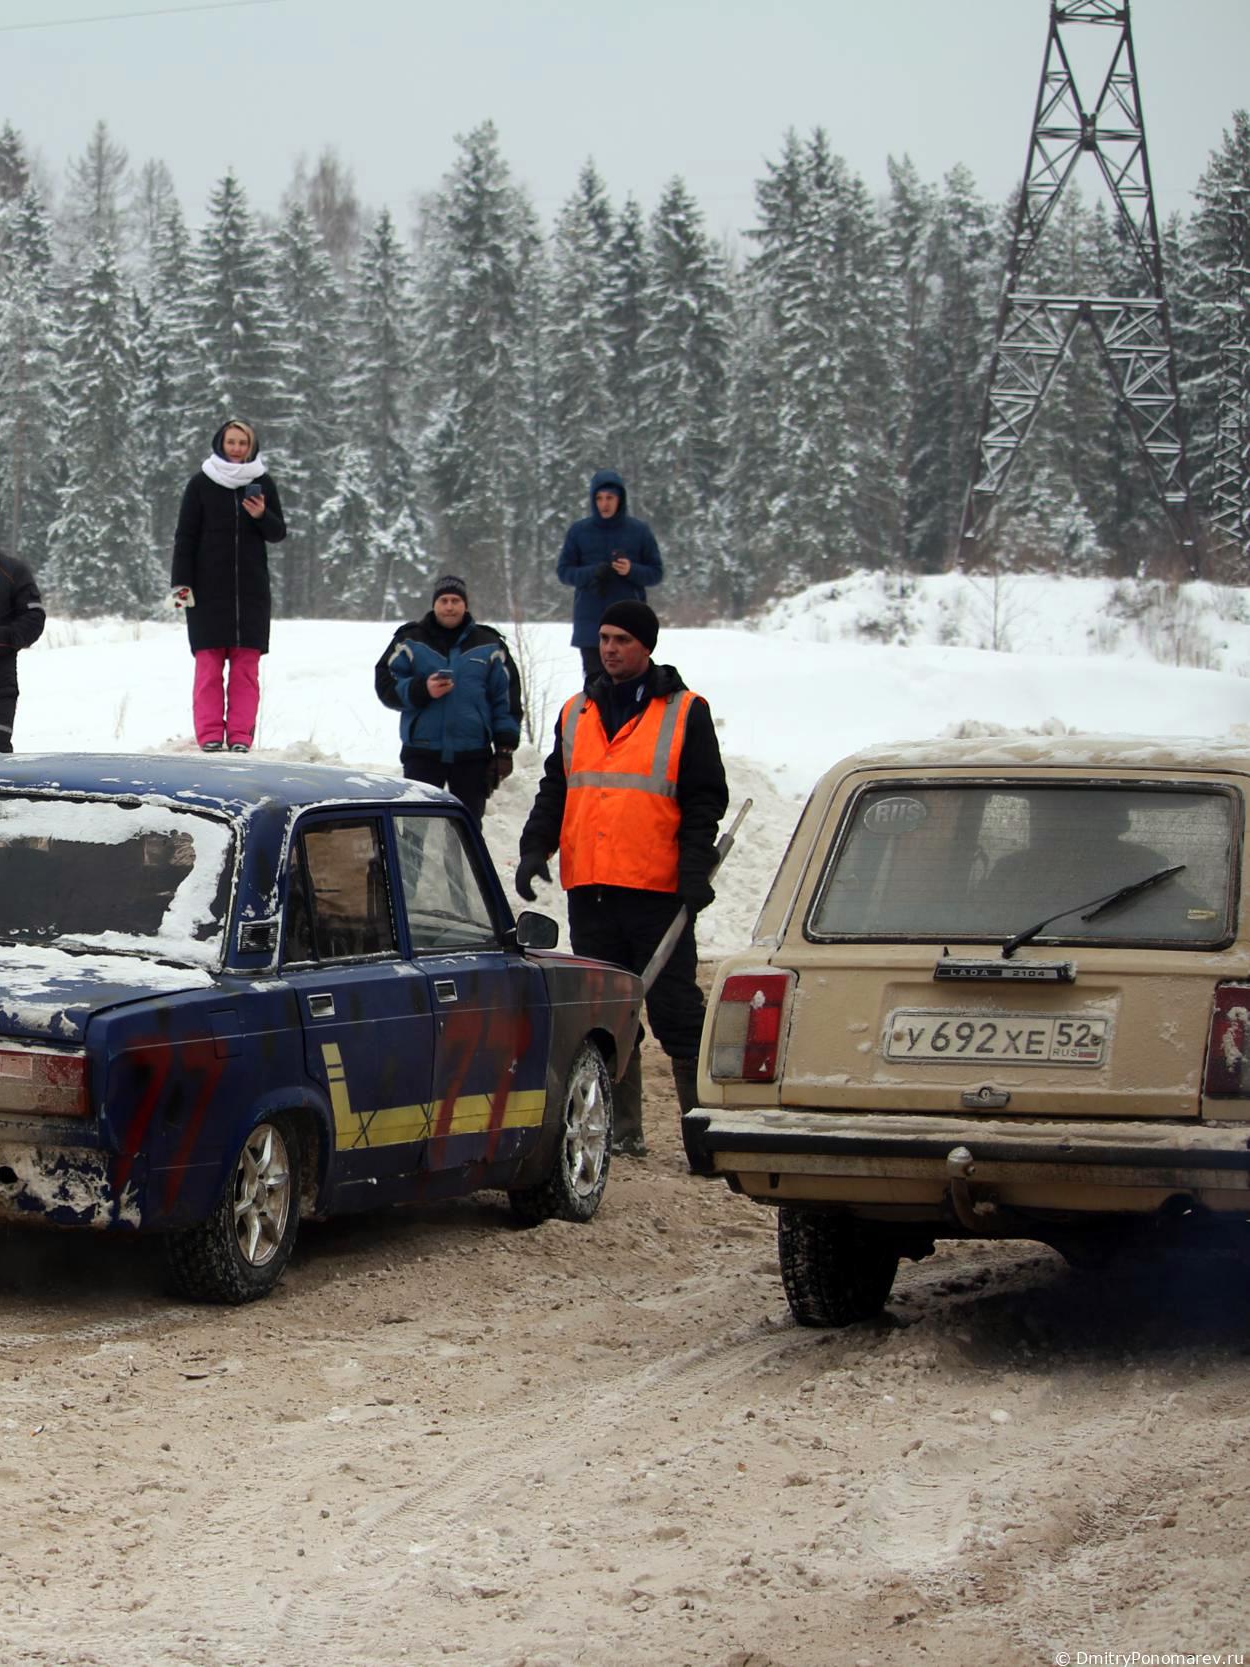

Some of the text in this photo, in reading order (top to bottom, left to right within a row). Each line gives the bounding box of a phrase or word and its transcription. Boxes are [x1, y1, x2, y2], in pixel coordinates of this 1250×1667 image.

[875, 804, 921, 822] RUS
[950, 968, 989, 977] LADA
[1056, 1023, 1089, 1048] 52
[1052, 1048, 1078, 1058] RUS
